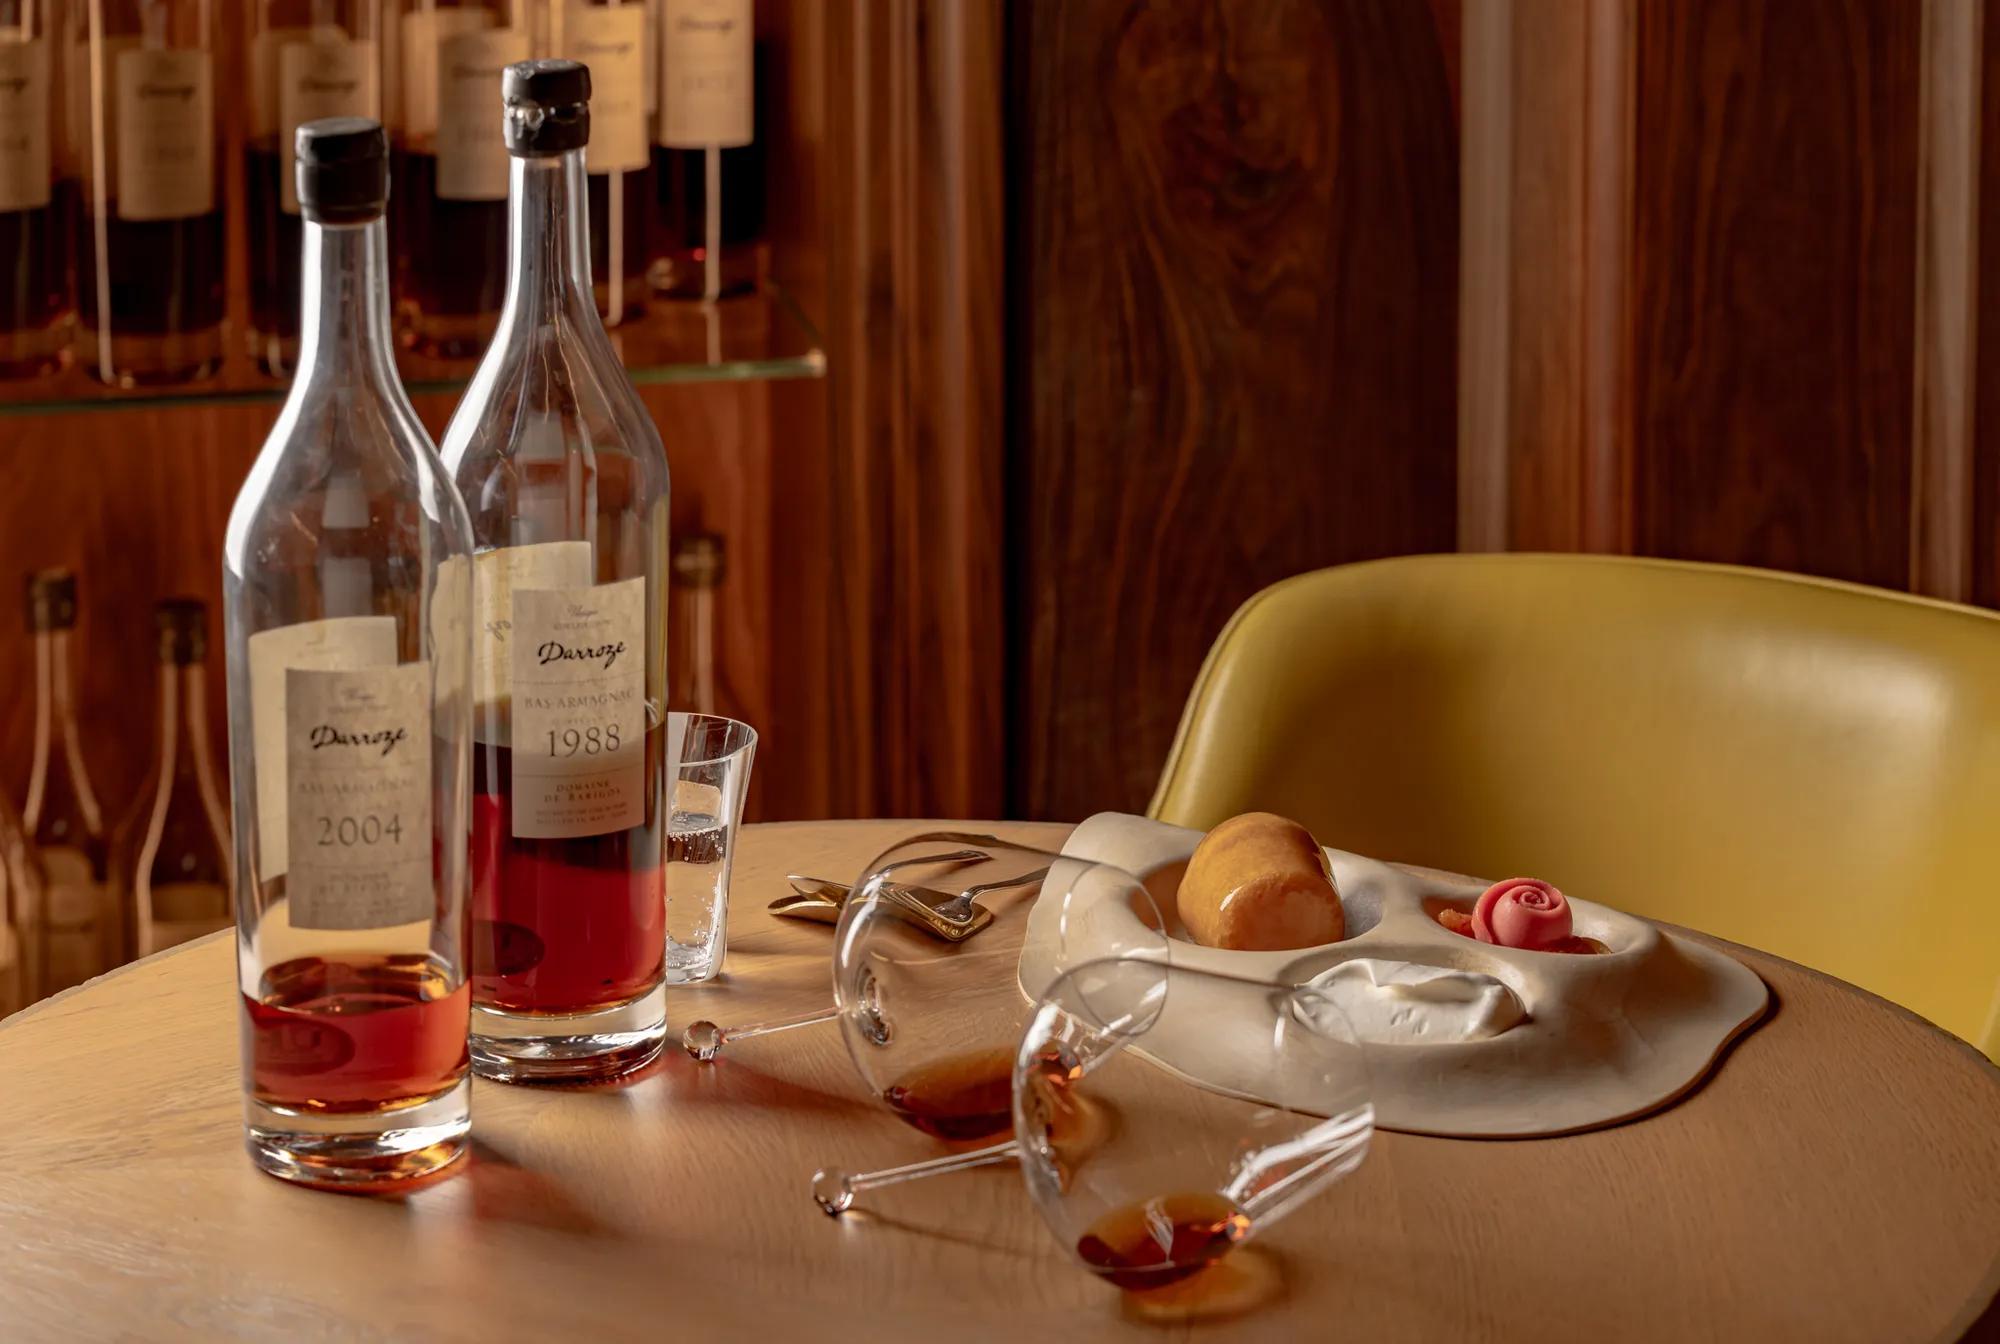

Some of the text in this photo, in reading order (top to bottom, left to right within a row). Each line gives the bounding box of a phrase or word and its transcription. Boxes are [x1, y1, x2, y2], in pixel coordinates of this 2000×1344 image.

[538, 641, 625, 669] Darroze
[310, 725, 407, 756] Darroze
[547, 723, 621, 758] 1988
[317, 814, 403, 846] 2004
